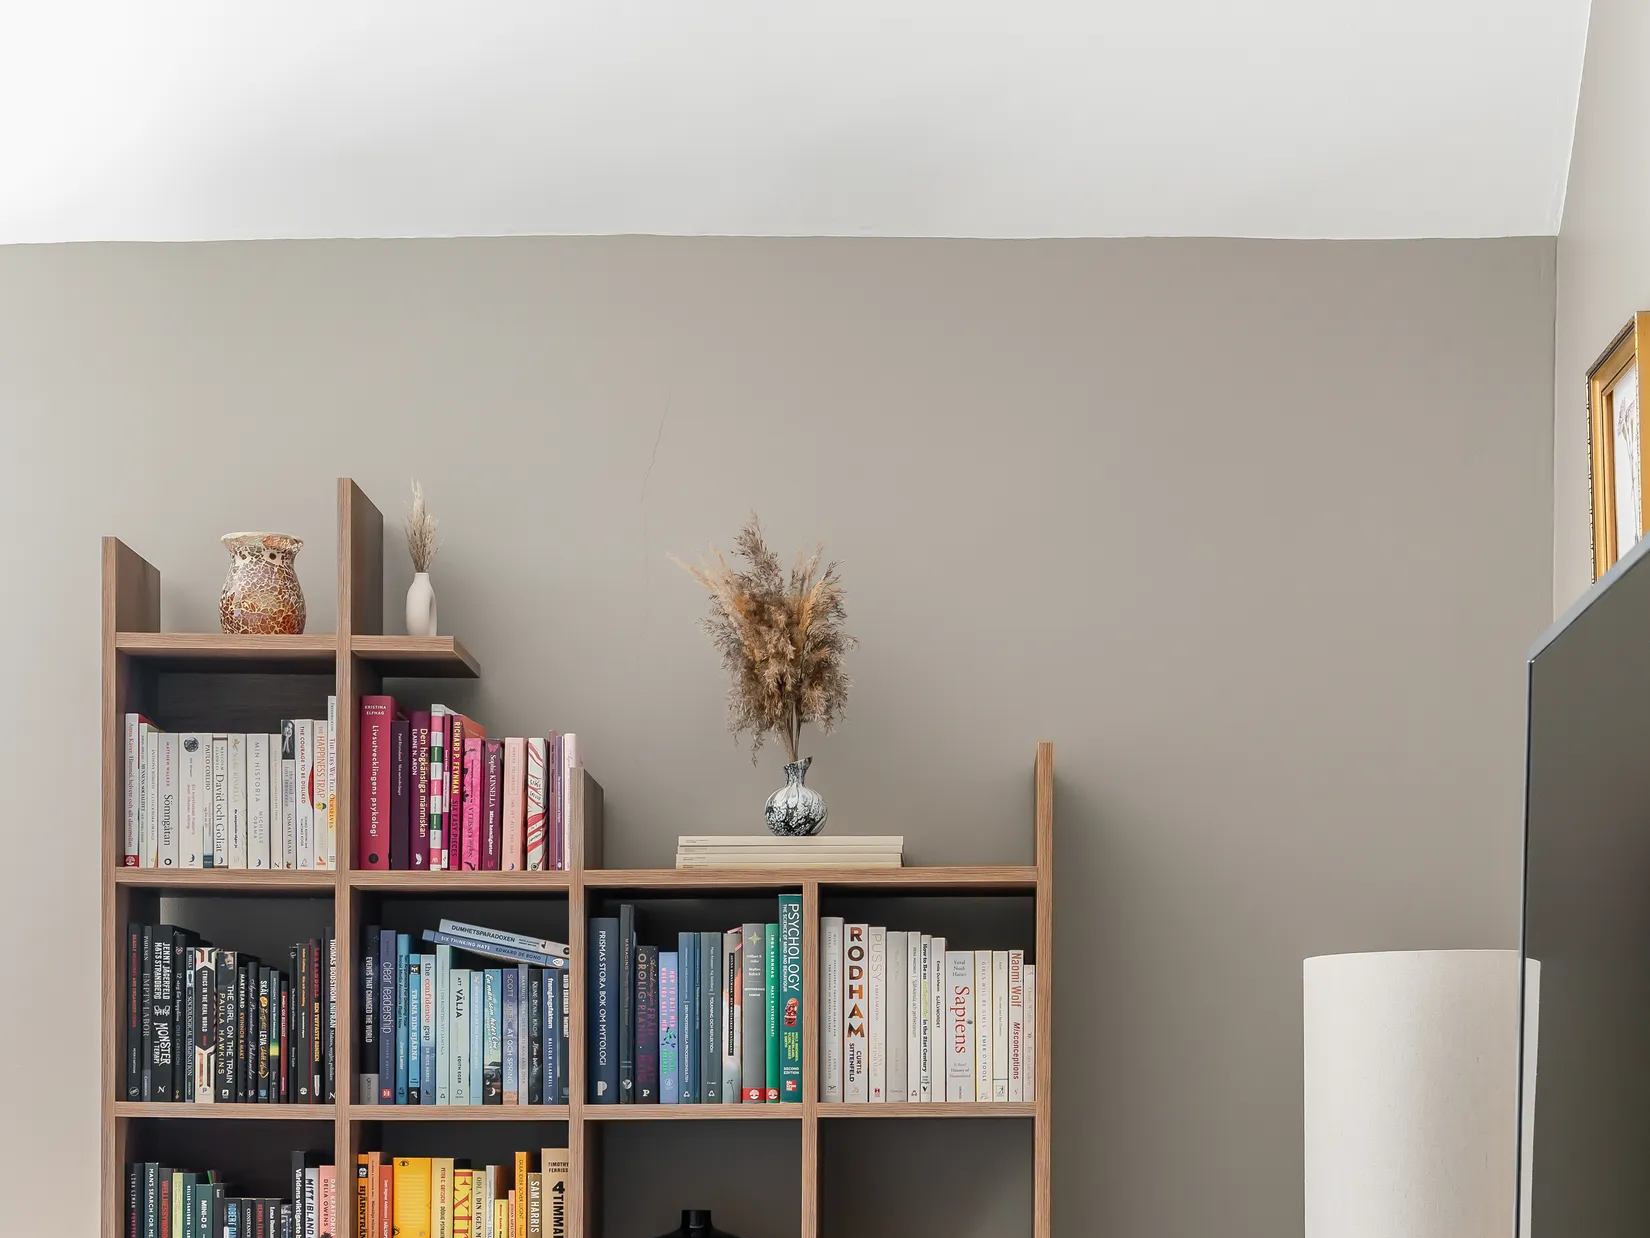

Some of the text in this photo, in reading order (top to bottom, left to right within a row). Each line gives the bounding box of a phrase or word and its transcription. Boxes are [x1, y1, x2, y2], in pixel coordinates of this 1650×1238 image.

[418, 747, 428, 793] högkänsliga
[162, 794, 173, 846] Sömngåtan
[216, 774, 224, 852] David och Goliat
[451, 925, 515, 942] DUMHETSPARADOXEN
[788, 904, 799, 991] PSYCHOLOGY
[872, 933, 882, 982] PUSSY
[381, 962, 393, 1033] clear leadership
[456, 989, 464, 1018] VÄLJA
[847, 927, 865, 1038] RODHAM
[227, 1026, 233, 1037] ON
[599, 1009, 606, 1022] OM
[950, 986, 972, 1053] Sapiens
[1011, 953, 1021, 1079] Naomi Wolf Misconceptions
[153, 1022, 171, 1066] MONSTER
[228, 1204, 236, 1226] ROBERT
[531, 1181, 540, 1233] SAM HARRIS
